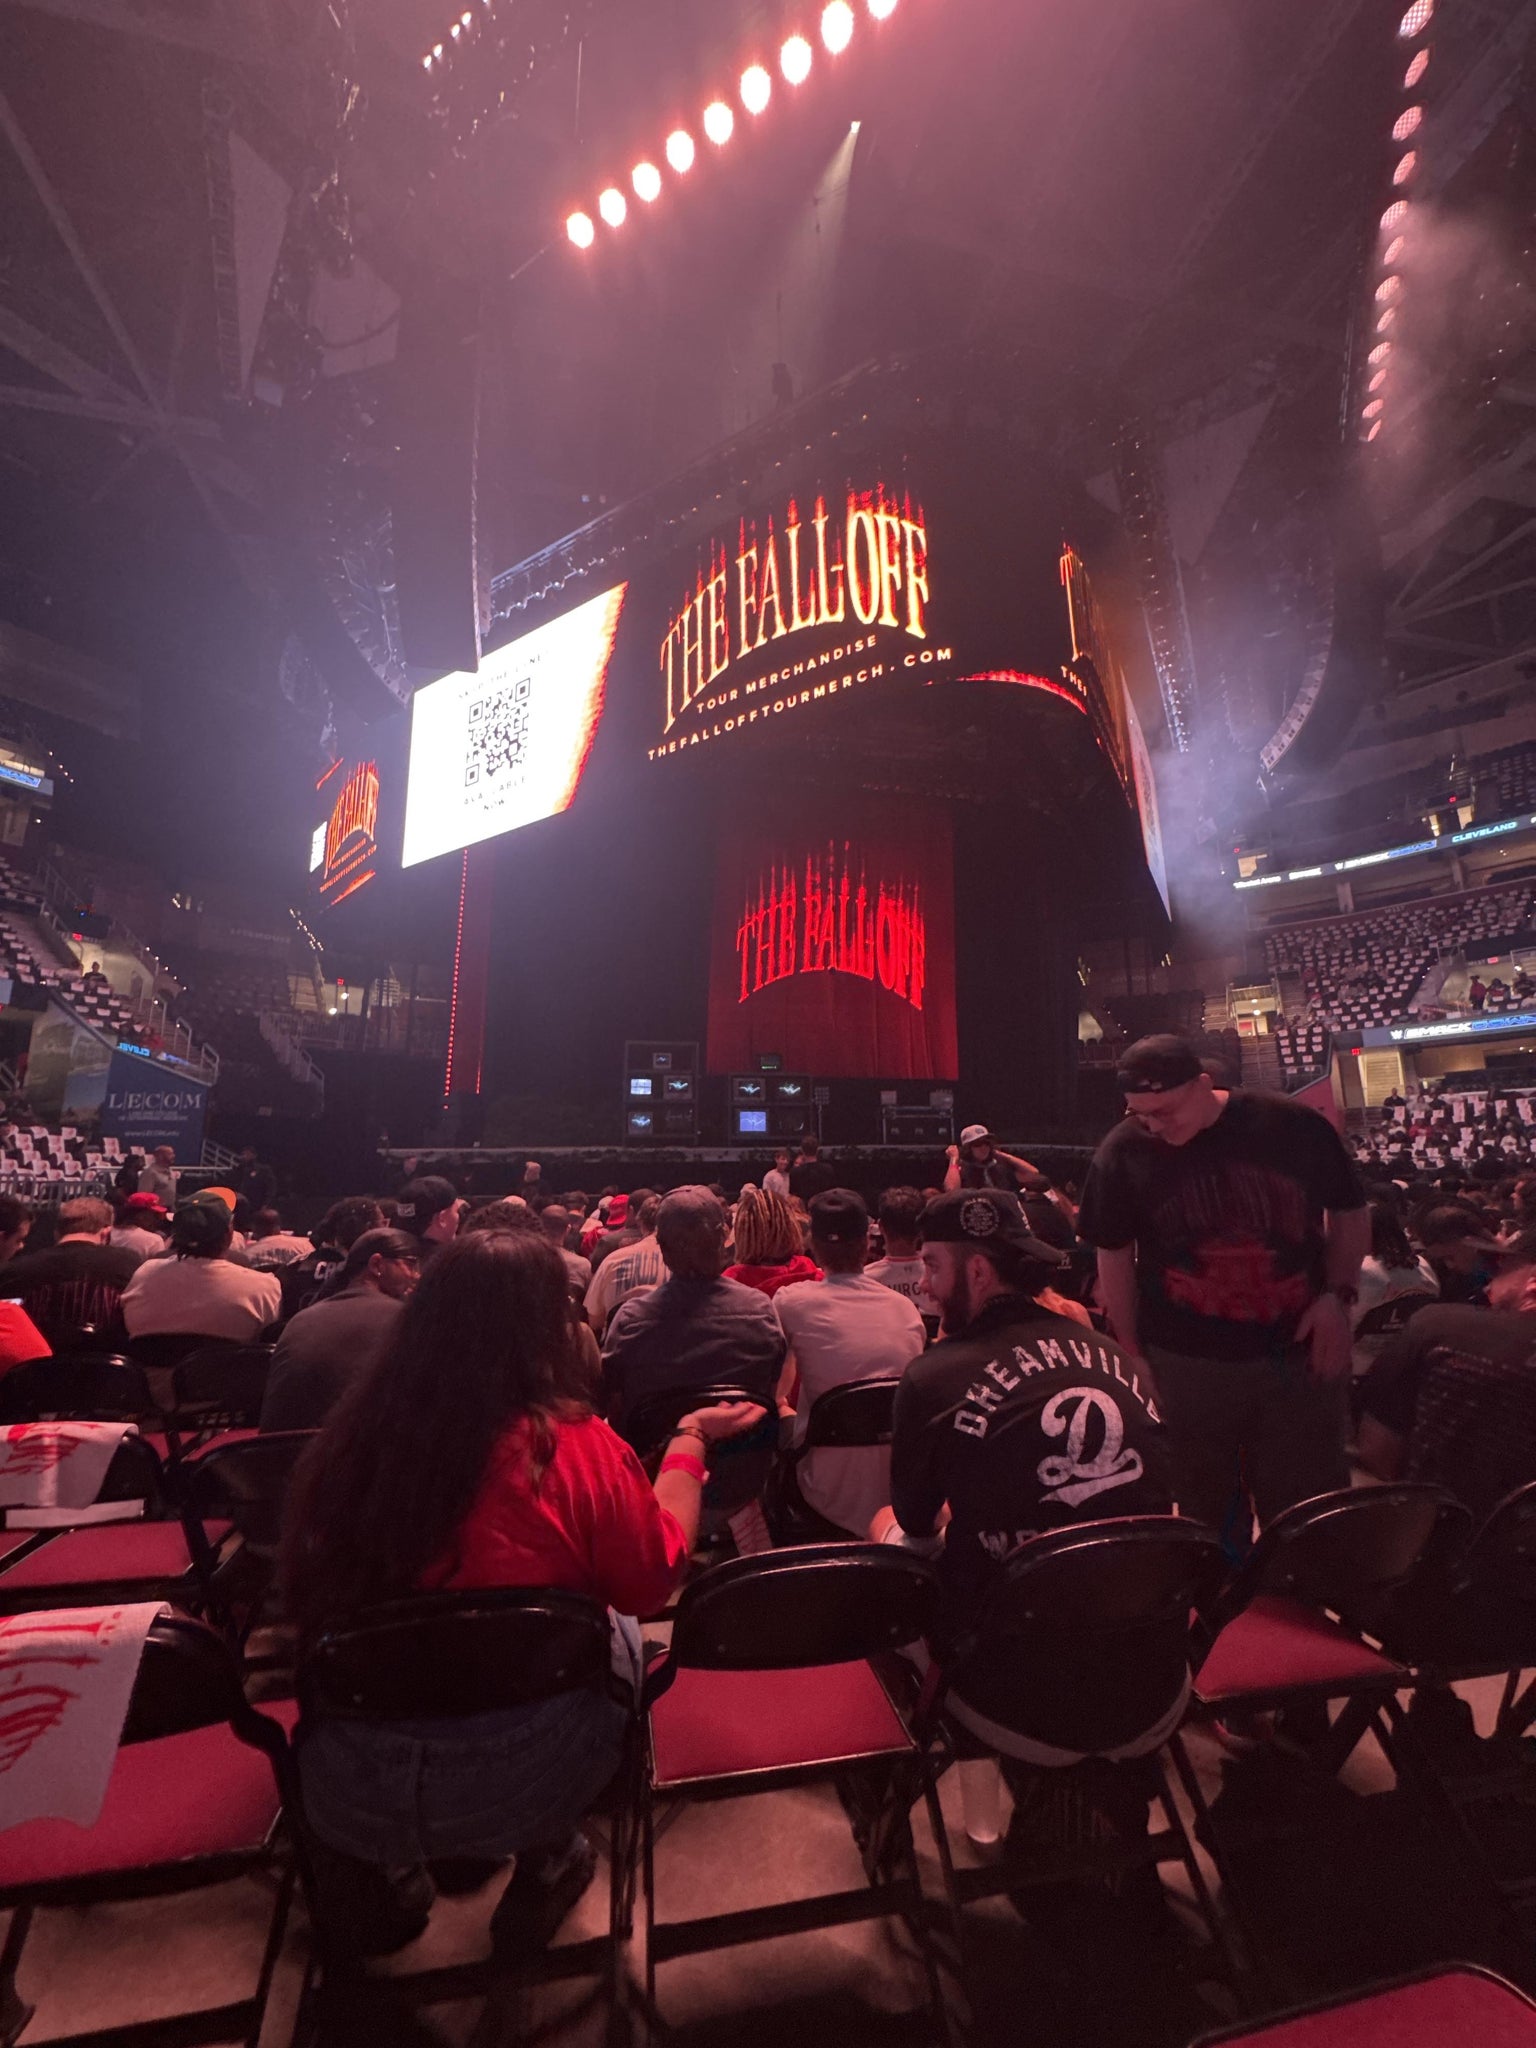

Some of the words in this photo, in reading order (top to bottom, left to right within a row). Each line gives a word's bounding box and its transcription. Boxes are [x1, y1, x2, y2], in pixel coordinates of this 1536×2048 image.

[660, 570, 729, 735] THE
[697, 688, 738, 714] TOUR
[745, 634, 878, 696] MERCHANDISE
[1451, 821, 1518, 843] CLEVELAND
[108, 1091, 202, 1110] LECOM
